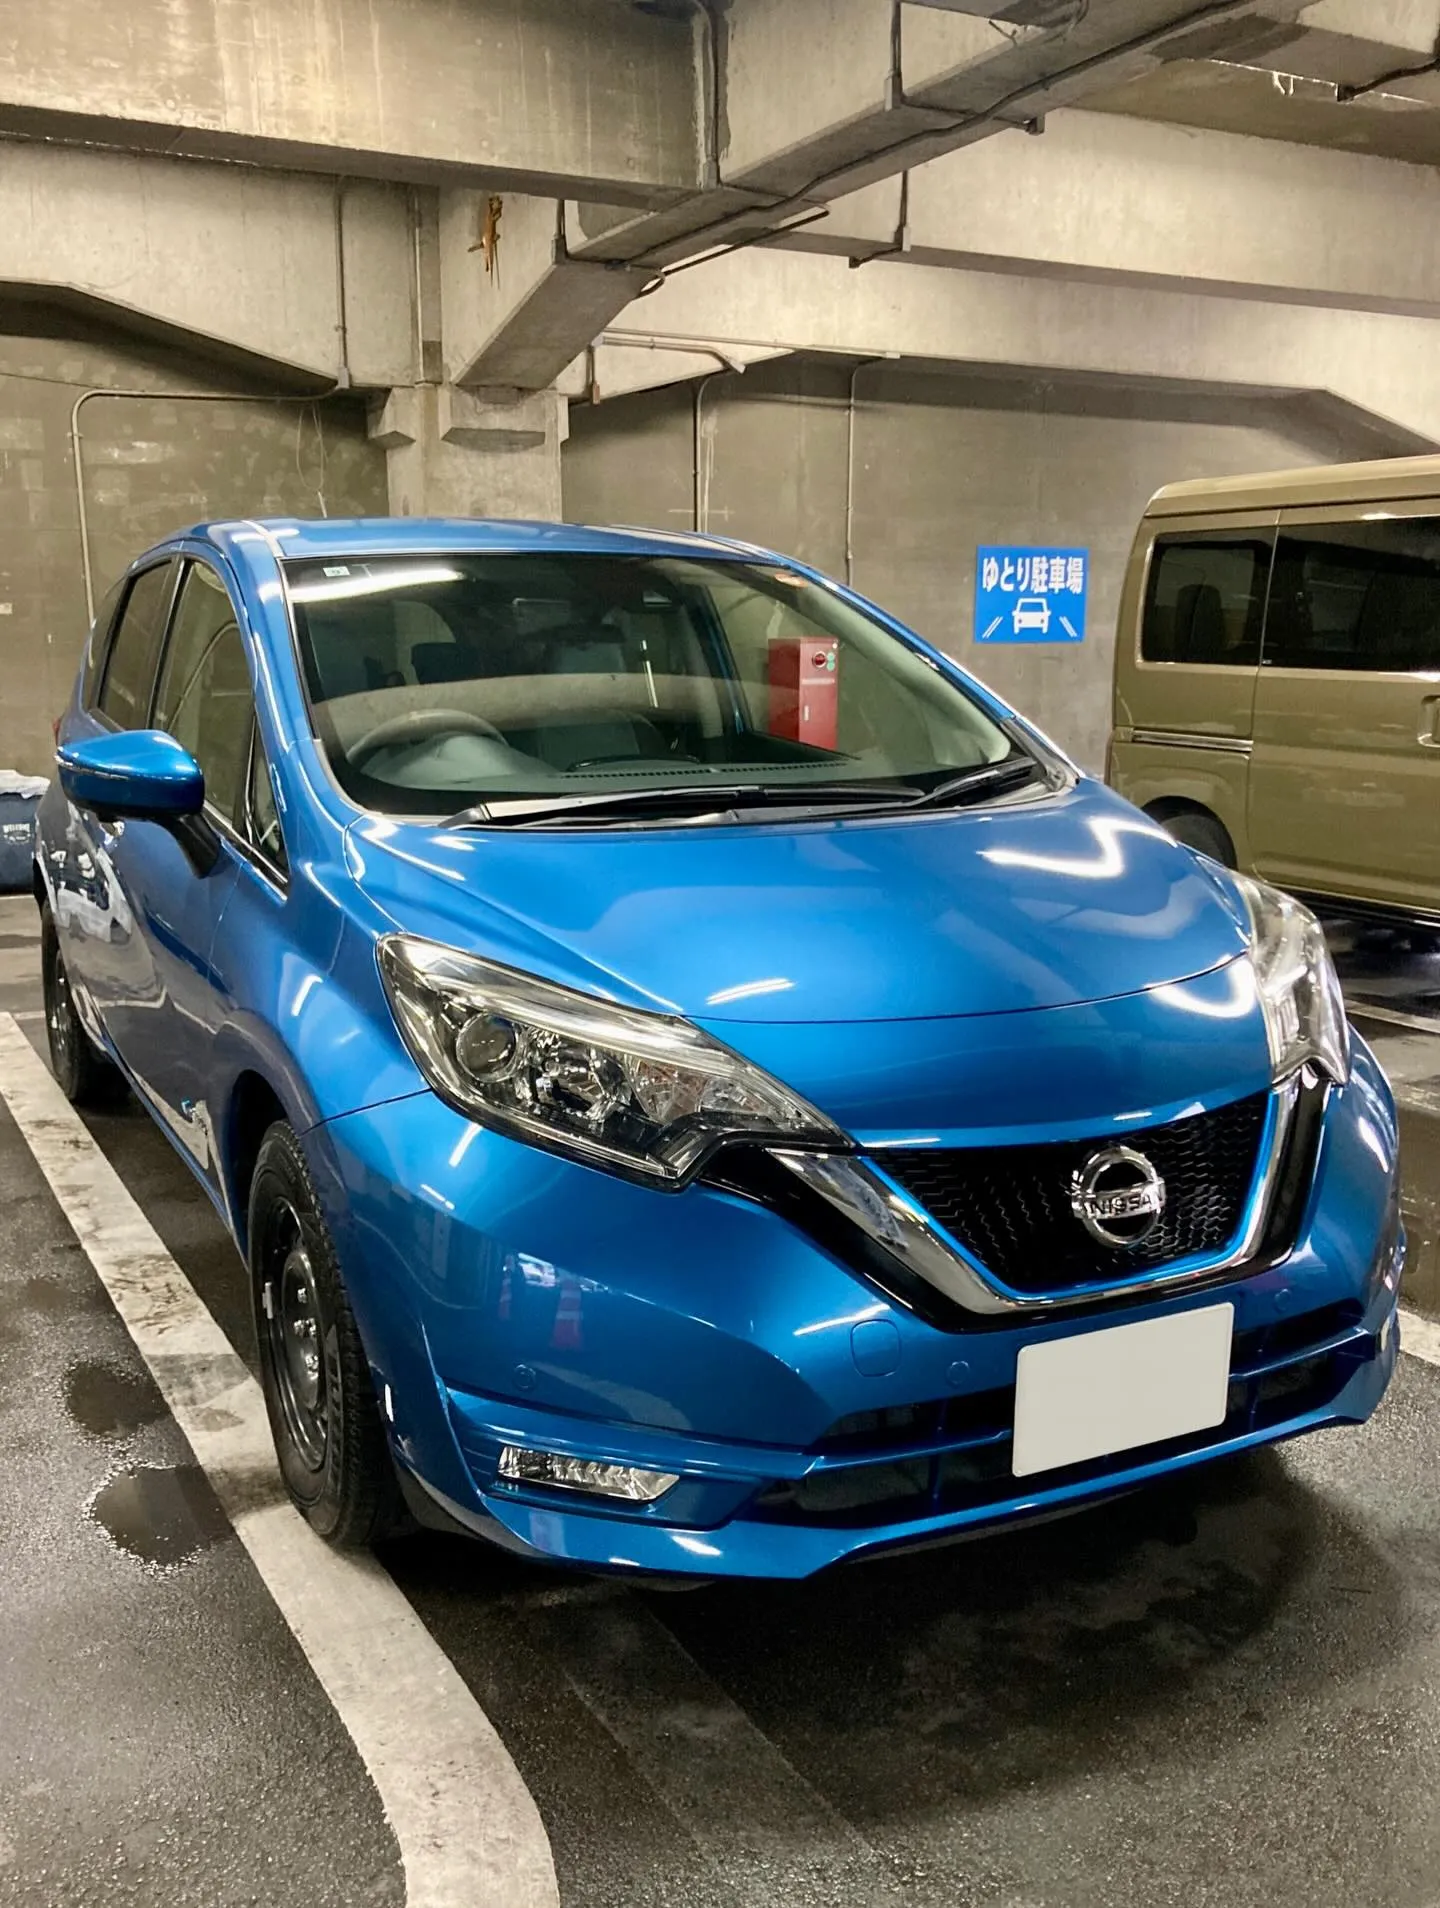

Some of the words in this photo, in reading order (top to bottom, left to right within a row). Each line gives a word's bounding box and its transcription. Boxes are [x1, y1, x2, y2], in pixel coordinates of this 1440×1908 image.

[982, 556, 1084, 594] ゆとり駐車場
[1086, 1194, 1161, 1215] NISSA
